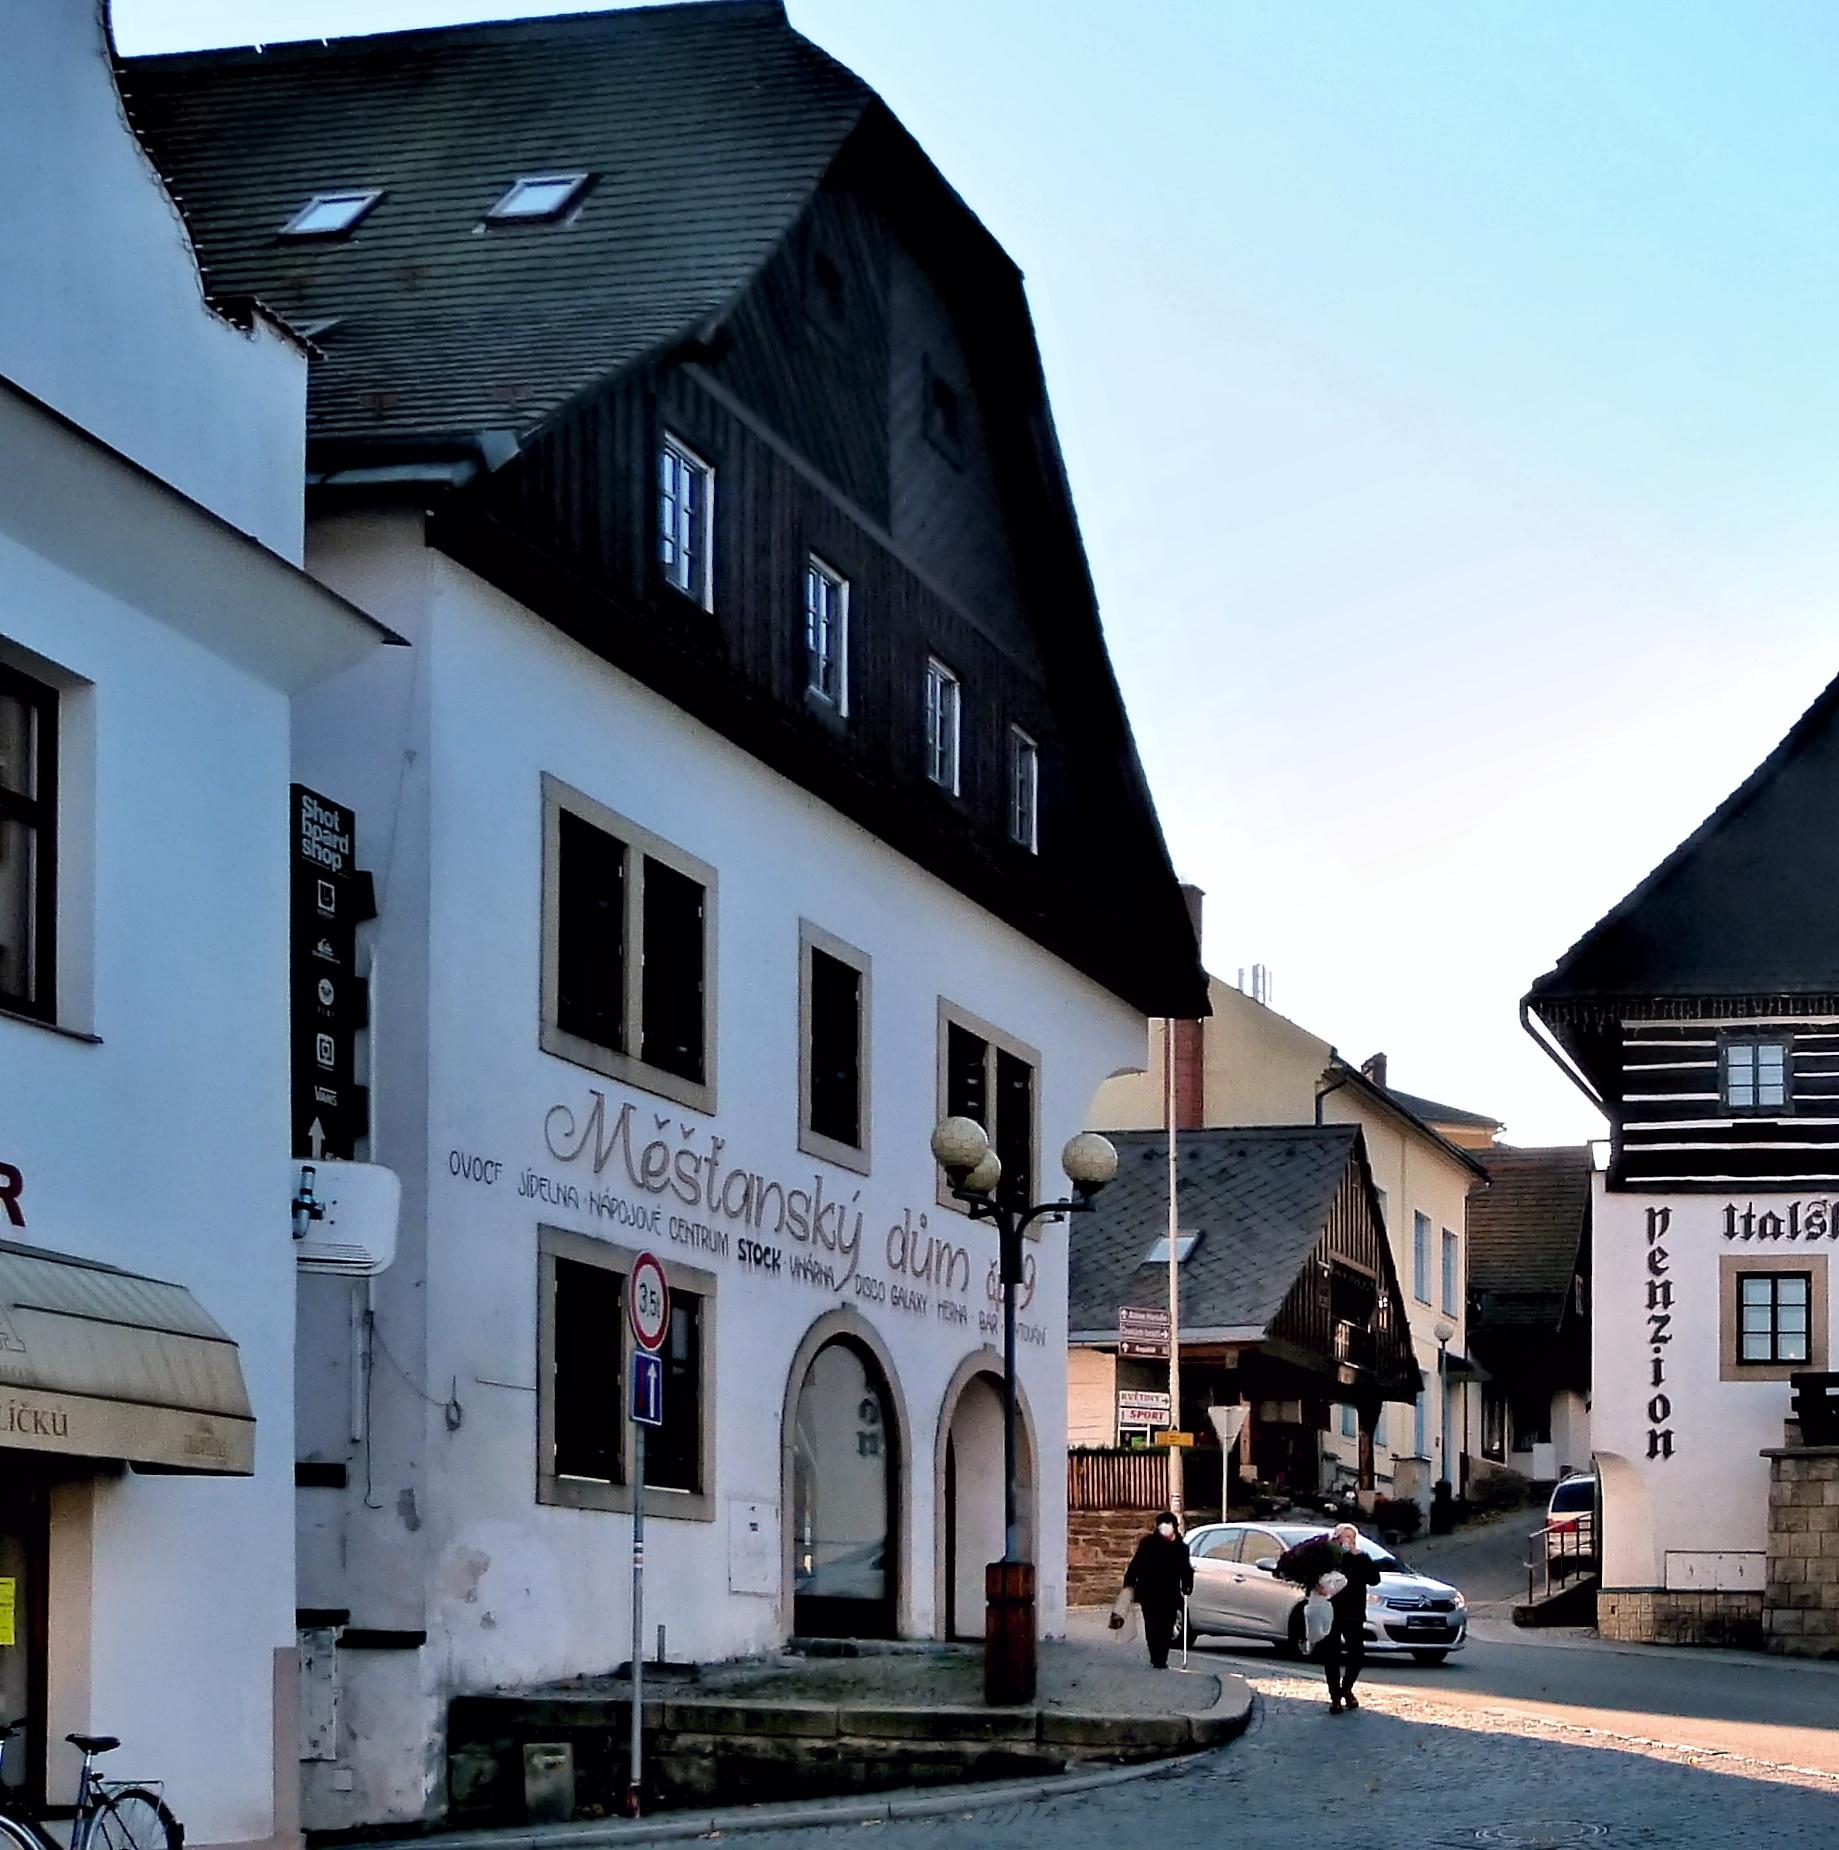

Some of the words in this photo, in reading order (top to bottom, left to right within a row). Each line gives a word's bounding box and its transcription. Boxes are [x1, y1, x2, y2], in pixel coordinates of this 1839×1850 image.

[302, 795, 340, 832] Shot
[302, 808, 349, 855] board
[302, 838, 342, 872] shop
[517, 1167, 580, 1211] JÍDELNA
[590, 1187, 662, 1237] NÁPOJOVÉ
[669, 1216, 729, 1257] CENTRUM
[737, 1238, 782, 1272] STOCK
[855, 1273, 886, 1302] DISCO
[886, 1208, 970, 1292] dům
[1129, 1410, 1165, 1420] SPORT
